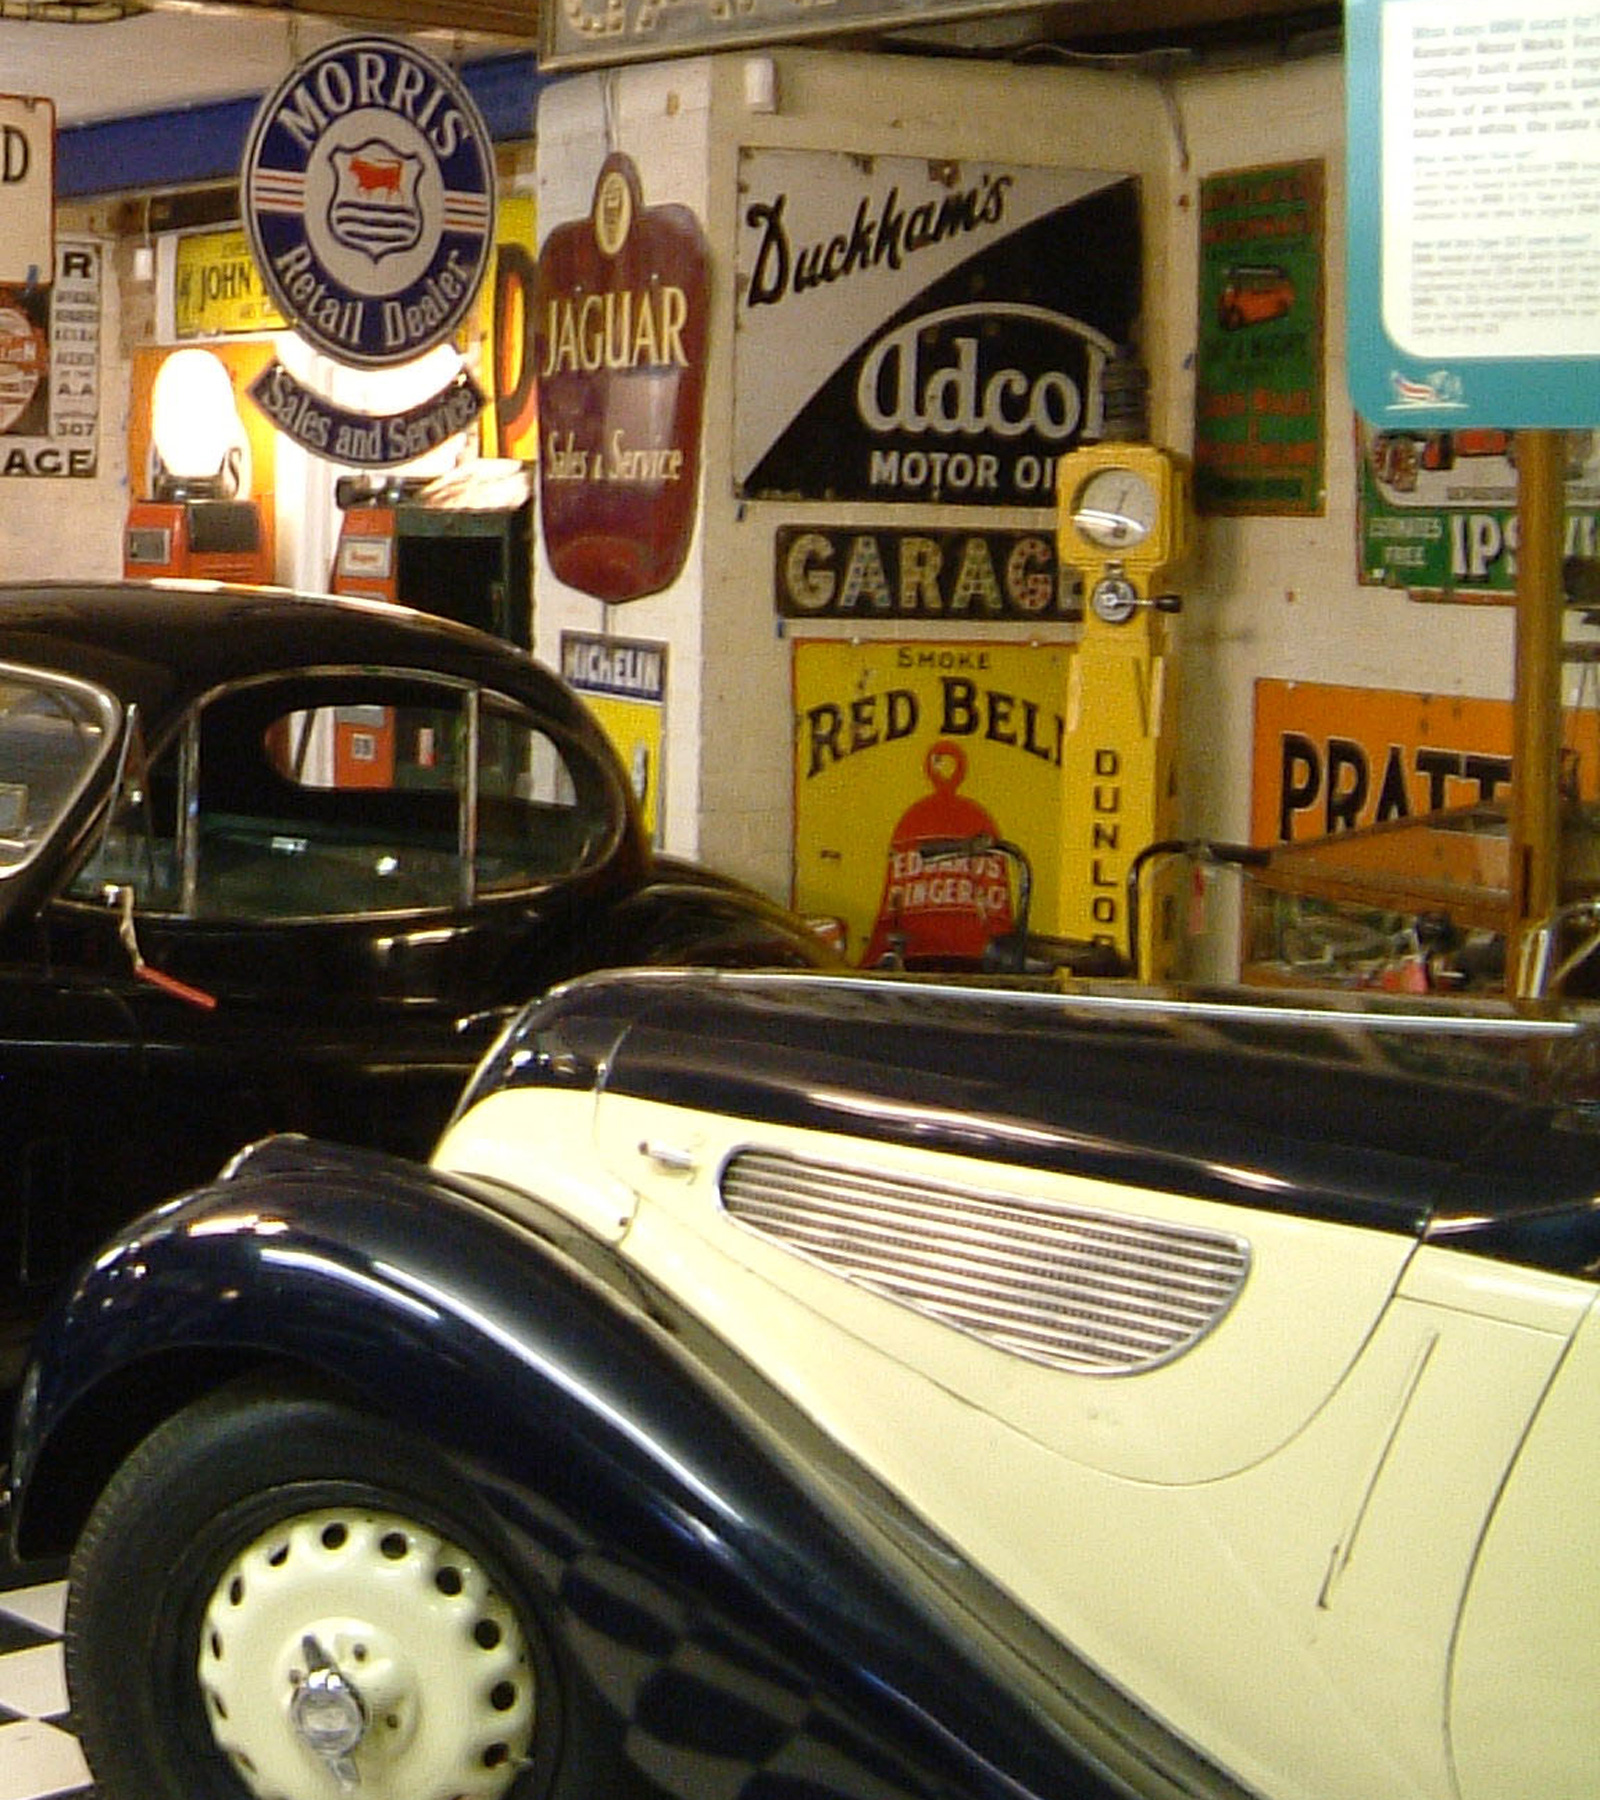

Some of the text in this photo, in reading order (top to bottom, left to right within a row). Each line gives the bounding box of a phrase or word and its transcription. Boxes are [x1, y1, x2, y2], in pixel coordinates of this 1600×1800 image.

[277, 49, 473, 159] MORRIS
[746, 174, 1013, 308] Duckham's
[276, 244, 474, 347] Retail Dealer
[545, 286, 688, 377] JAGUAR
[260, 371, 477, 462] Sales and Service
[608, 428, 684, 483] Service
[869, 450, 1057, 490] MOTOR OI
[897, 647, 991, 670] SMOKE
[807, 688, 919, 780] RED
